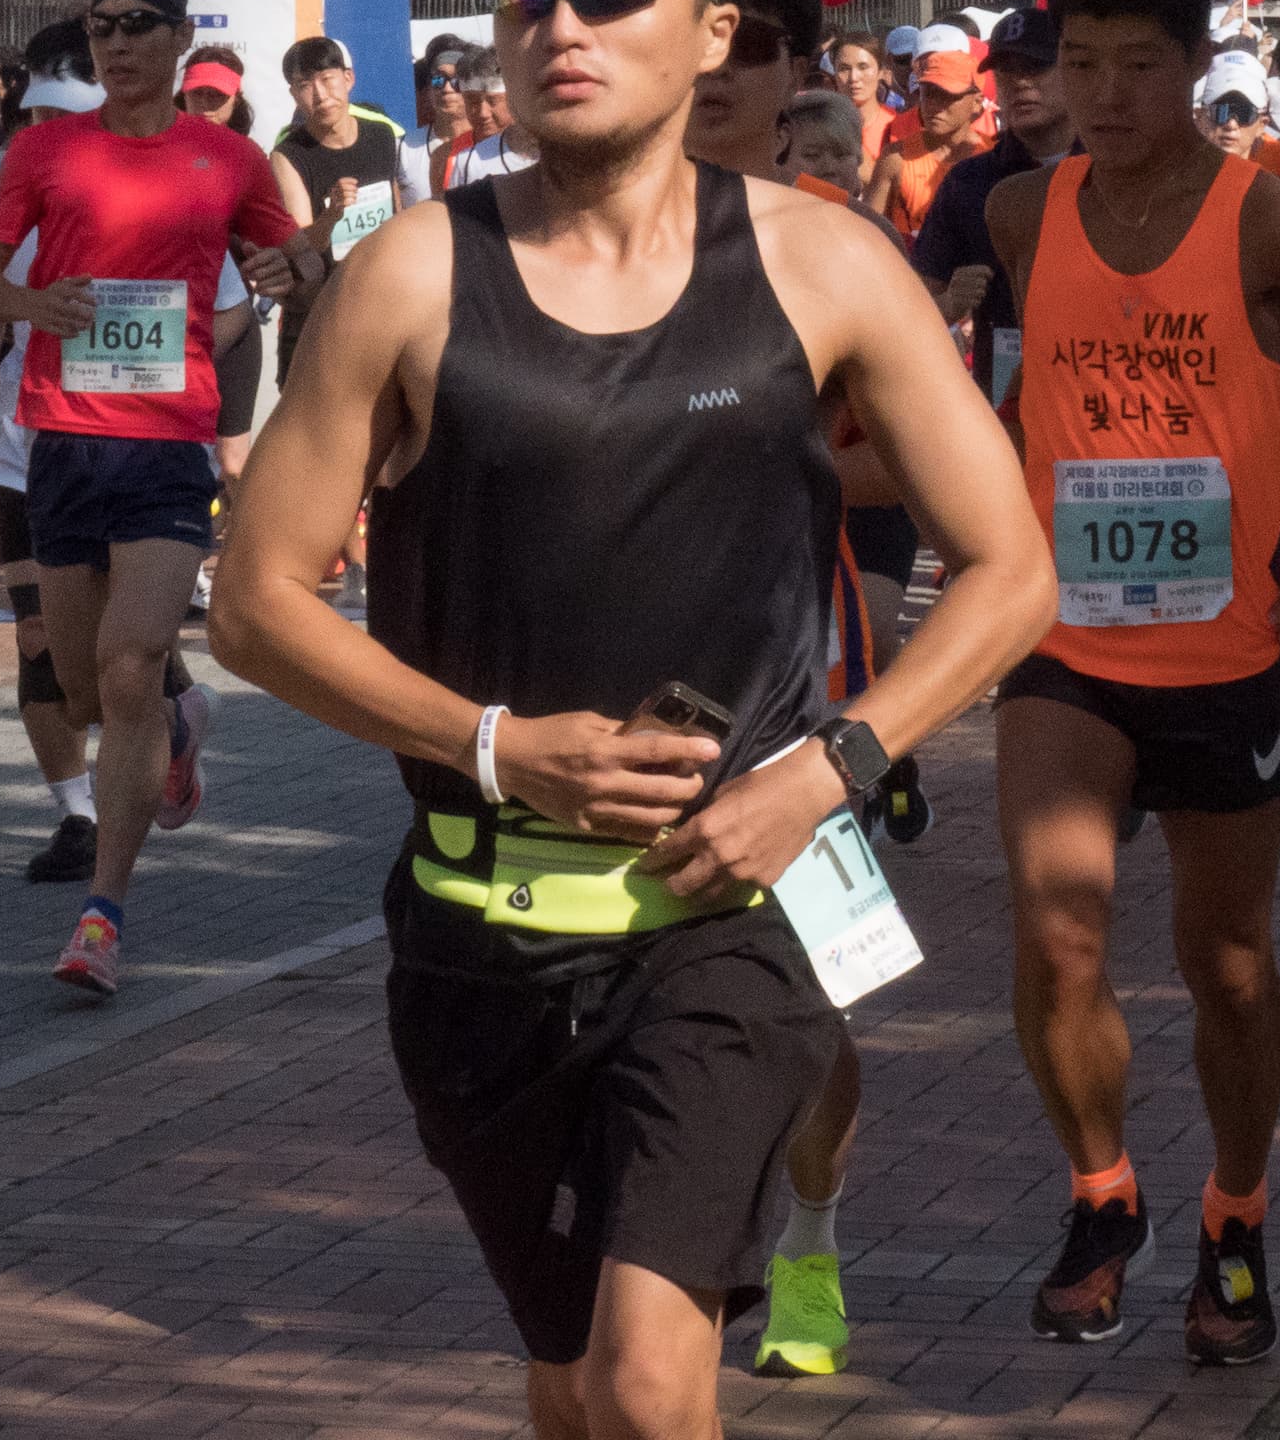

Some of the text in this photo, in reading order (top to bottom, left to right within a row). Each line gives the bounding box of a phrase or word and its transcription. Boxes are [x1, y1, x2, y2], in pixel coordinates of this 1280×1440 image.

[89, 320, 164, 350] 1604
[1144, 312, 1210, 340] VMK
[1051, 338, 1217, 386] 시각장애인
[1083, 519, 1200, 563] 1078
